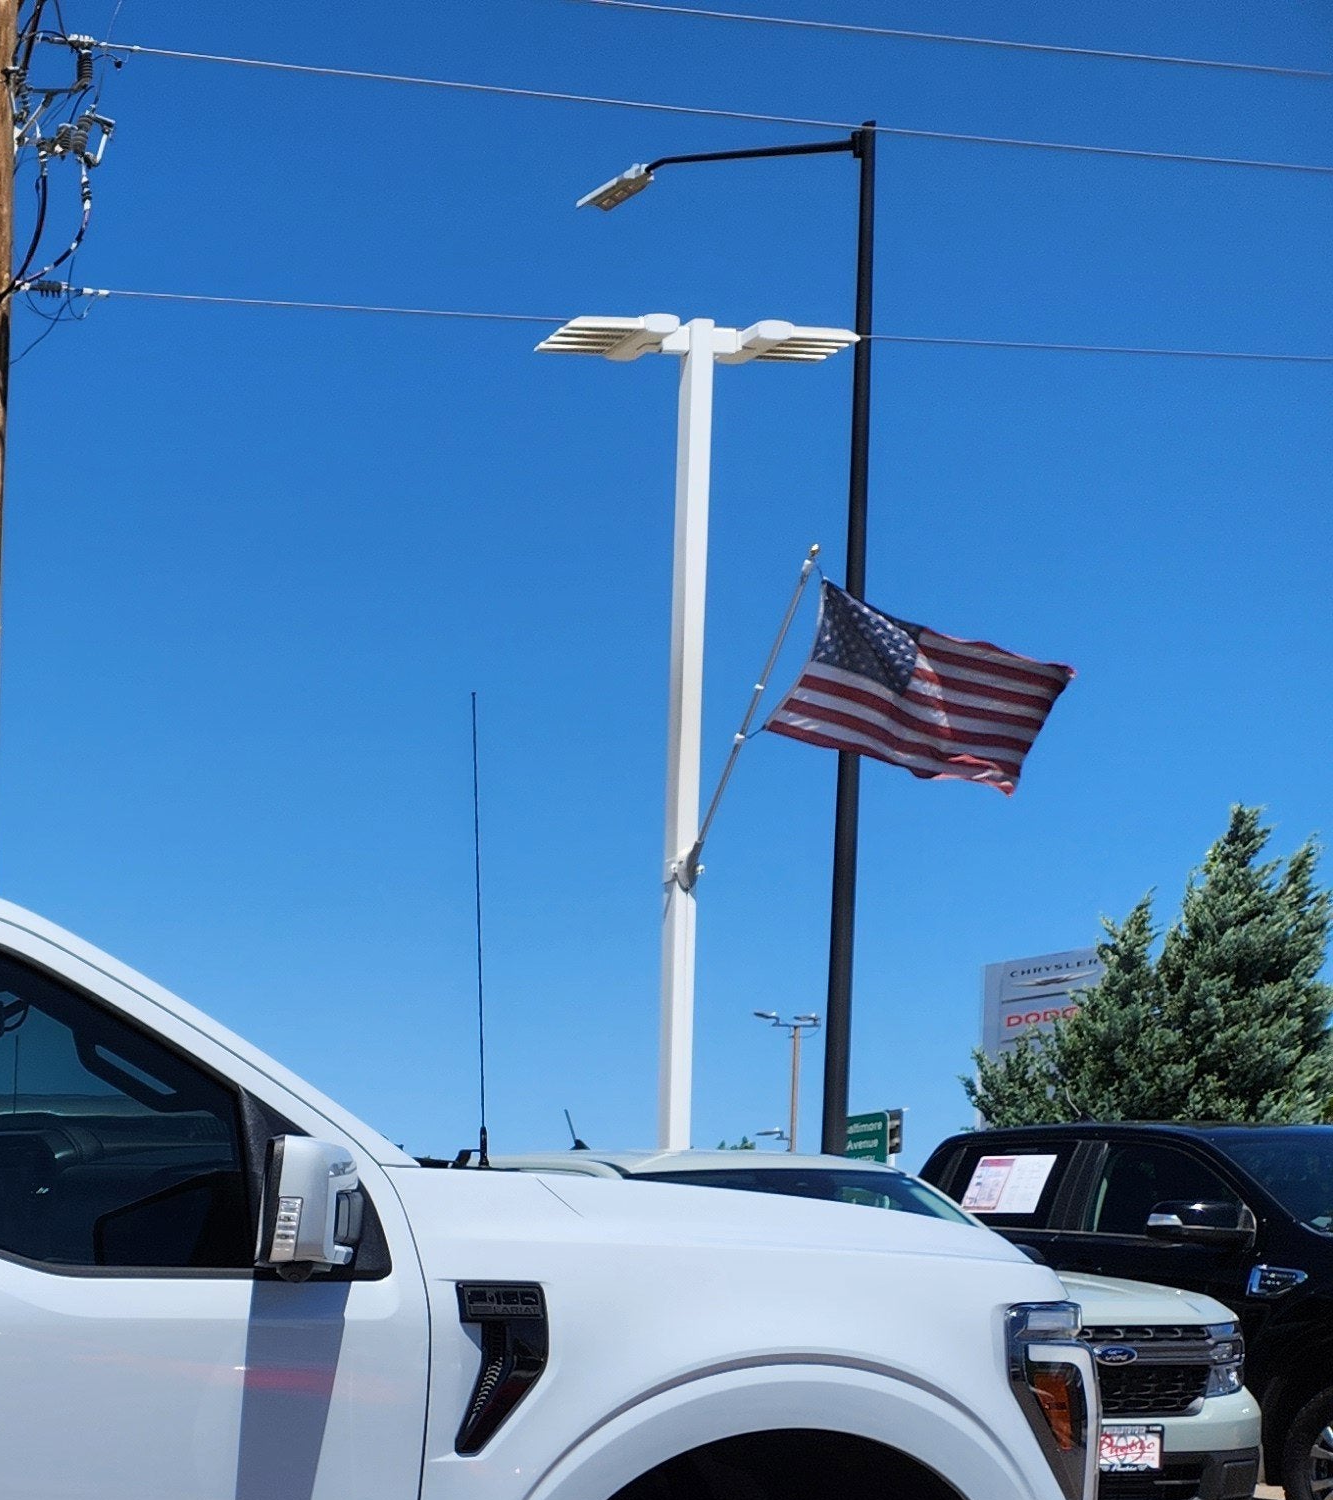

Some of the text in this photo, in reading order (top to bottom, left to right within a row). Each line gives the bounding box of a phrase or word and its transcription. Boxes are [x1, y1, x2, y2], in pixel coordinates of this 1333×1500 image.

[1009, 958, 1098, 978] CHRYSLER
[846, 1121, 883, 1134] altimore
[845, 1139, 879, 1151] Avenue
